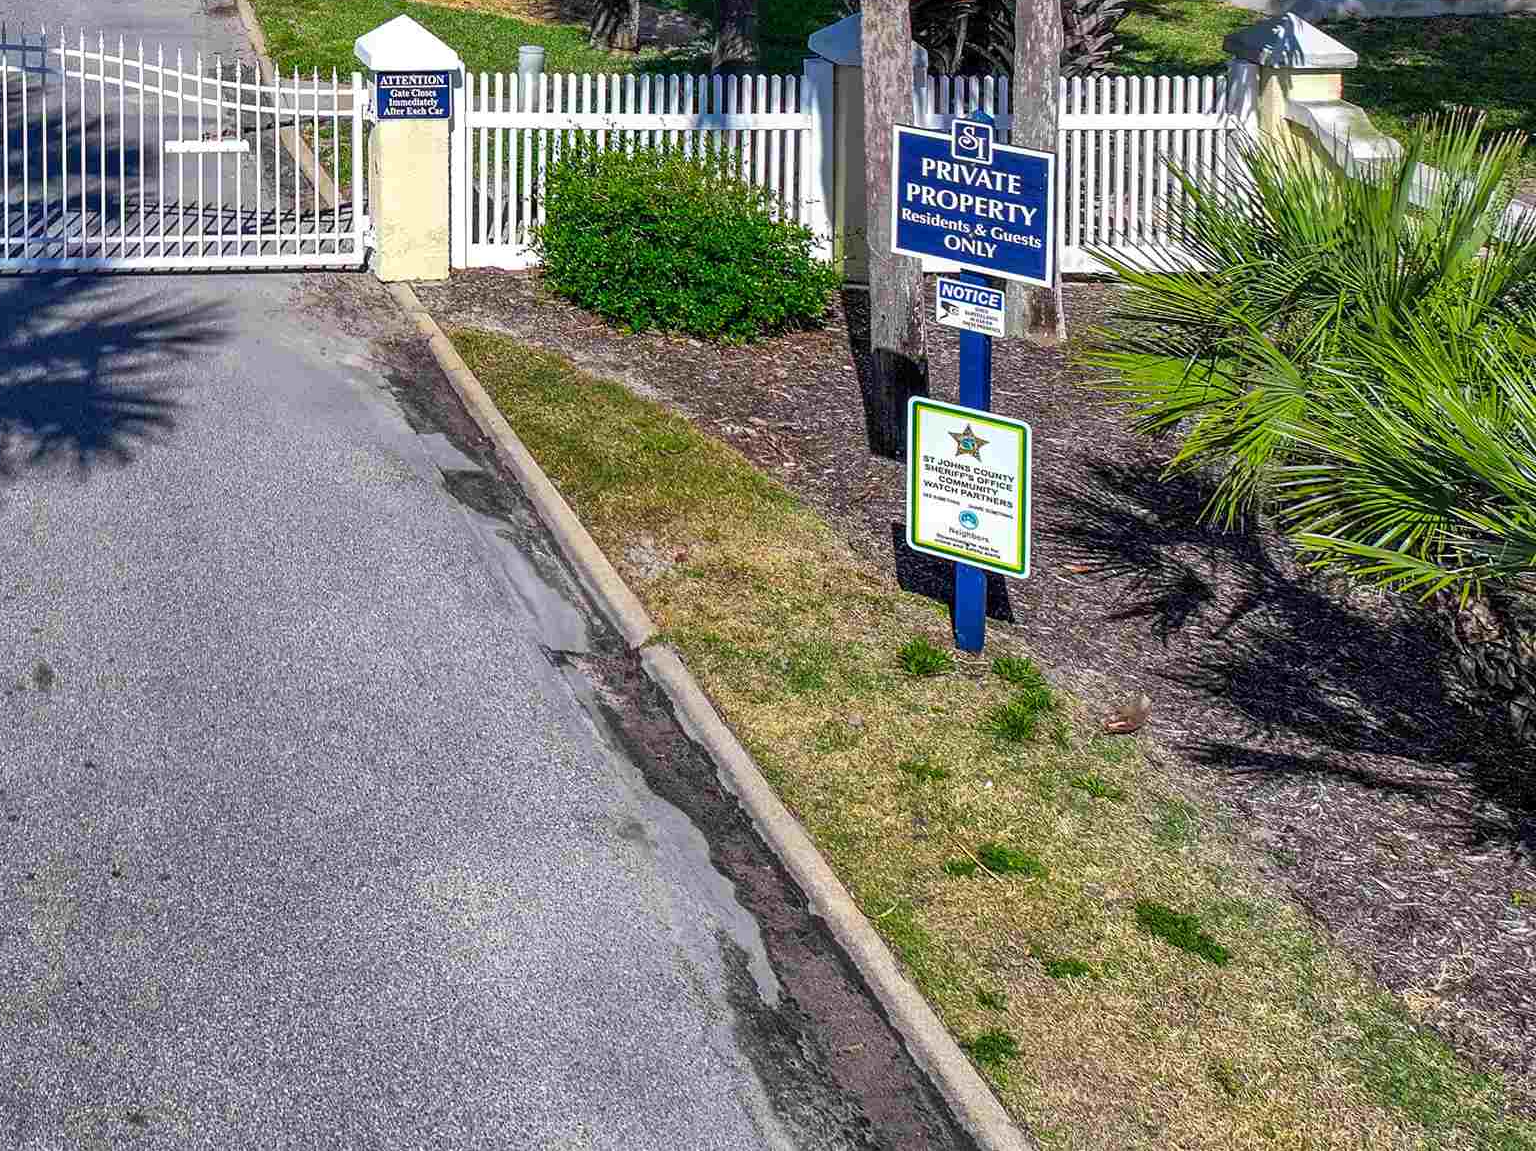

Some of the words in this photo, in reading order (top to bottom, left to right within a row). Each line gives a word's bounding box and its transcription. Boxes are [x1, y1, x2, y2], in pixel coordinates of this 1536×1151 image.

[380, 75, 444, 85] ATTENTION
[389, 98, 439, 109] Immediately
[390, 89, 410, 98] Gate
[411, 89, 437, 98] Closes
[384, 107, 404, 115] After
[406, 107, 427, 115] Each
[428, 107, 443, 115] Car
[921, 157, 1022, 195] PRIVATE
[906, 182, 1038, 227] PROPERTY
[901, 208, 971, 233] Residents
[974, 223, 987, 237] &
[990, 226, 1042, 249] Guests
[944, 234, 998, 259] ONLY
[941, 283, 1002, 307] NOTICE
[923, 455, 936, 464] ST
[937, 458, 971, 473] JOHNS
[973, 467, 1015, 483] COUNTY
[924, 463, 975, 482] SHERIFF'S
[977, 476, 1013, 492] OFFICE
[923, 479, 958, 494] WATCH
[960, 489, 1014, 509] PARTNERS
[938, 475, 999, 496] COMMUNITY
